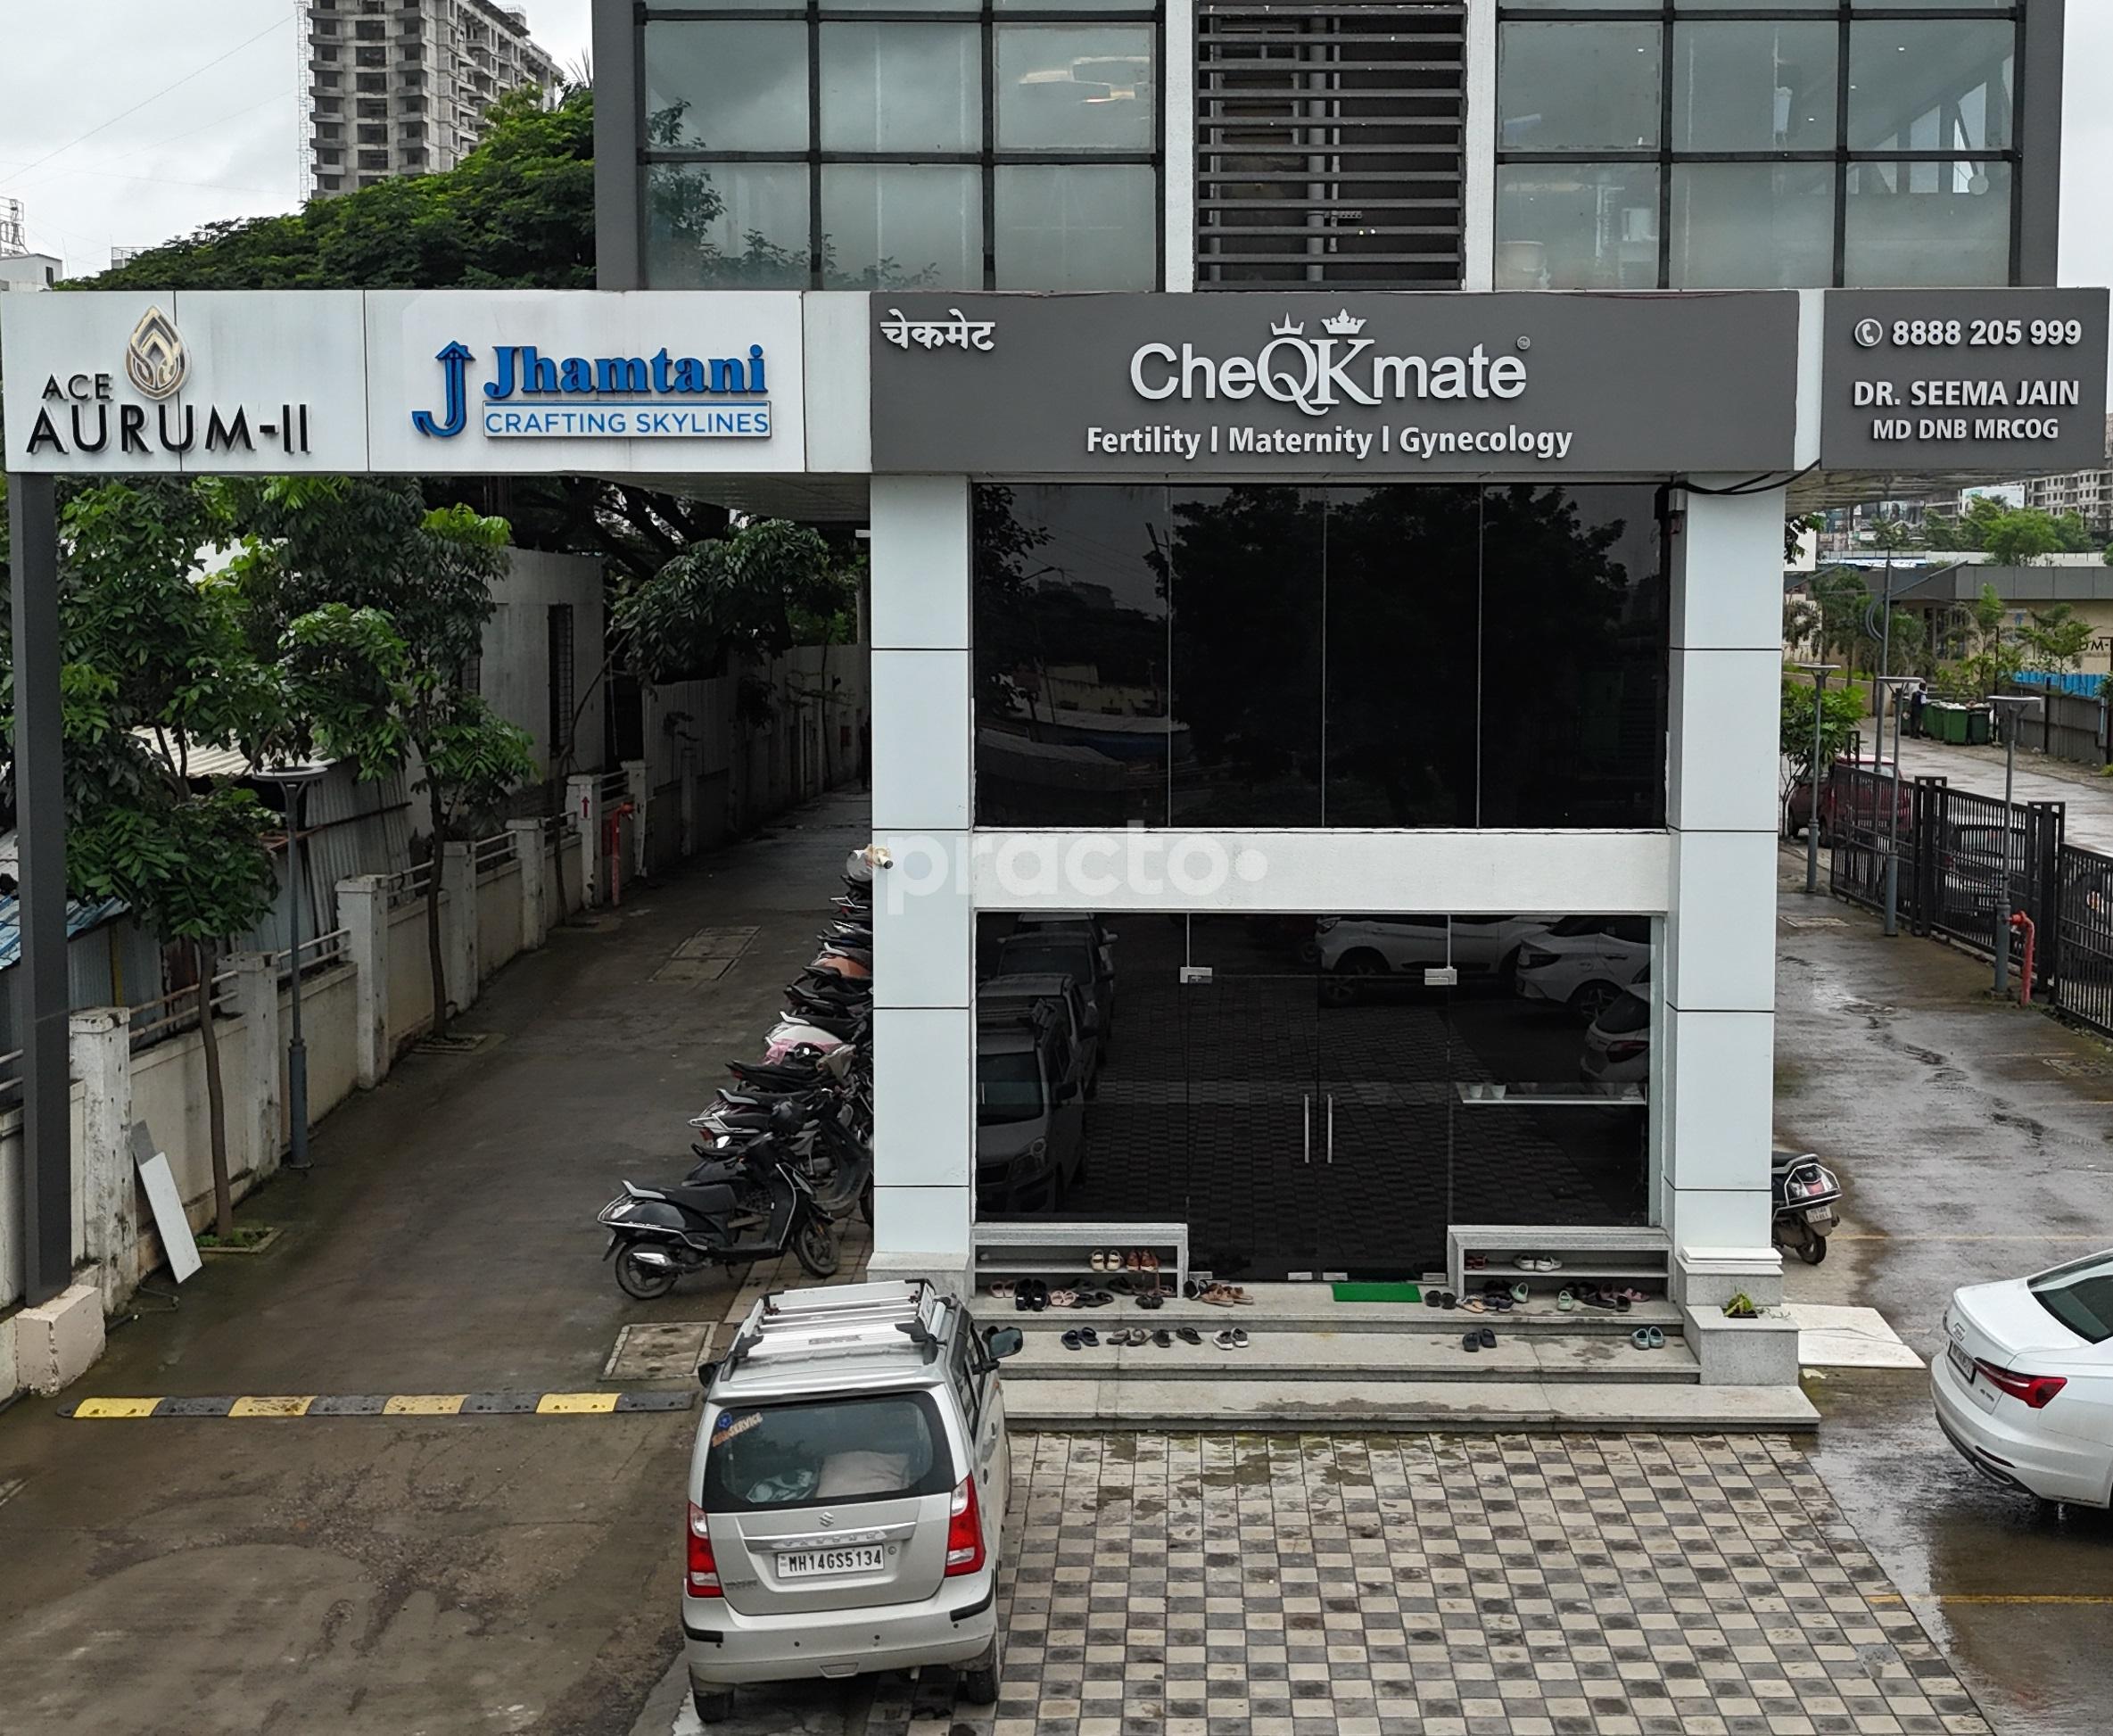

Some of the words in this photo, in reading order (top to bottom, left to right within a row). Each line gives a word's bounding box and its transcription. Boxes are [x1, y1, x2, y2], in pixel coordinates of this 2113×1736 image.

[879, 308, 996, 351] चेकमेट
[1893, 320, 1961, 345] 8888
[1969, 319, 2022, 345] 205
[2030, 319, 2083, 345] 999
[483, 344, 768, 394] Jhamtani
[1130, 338, 1527, 416] CheQKmate
[41, 373, 112, 401] ACE
[1854, 381, 1901, 406] DR.
[1911, 380, 2009, 406] SEEMA
[2016, 380, 2079, 406] JAIN
[26, 403, 310, 454] AURUM-II
[485, 413, 626, 433] CRAFTING
[636, 413, 768, 433] SKYLINES
[1873, 419, 1911, 440] MD
[1919, 419, 1967, 439] DNB
[1975, 419, 2059, 440] MRCOG
[1087, 426, 1201, 459] Fertility
[1229, 426, 1374, 459] Maternity
[1399, 424, 1573, 459] Gynecology
[788, 1550, 881, 1572] MH14GS5134
